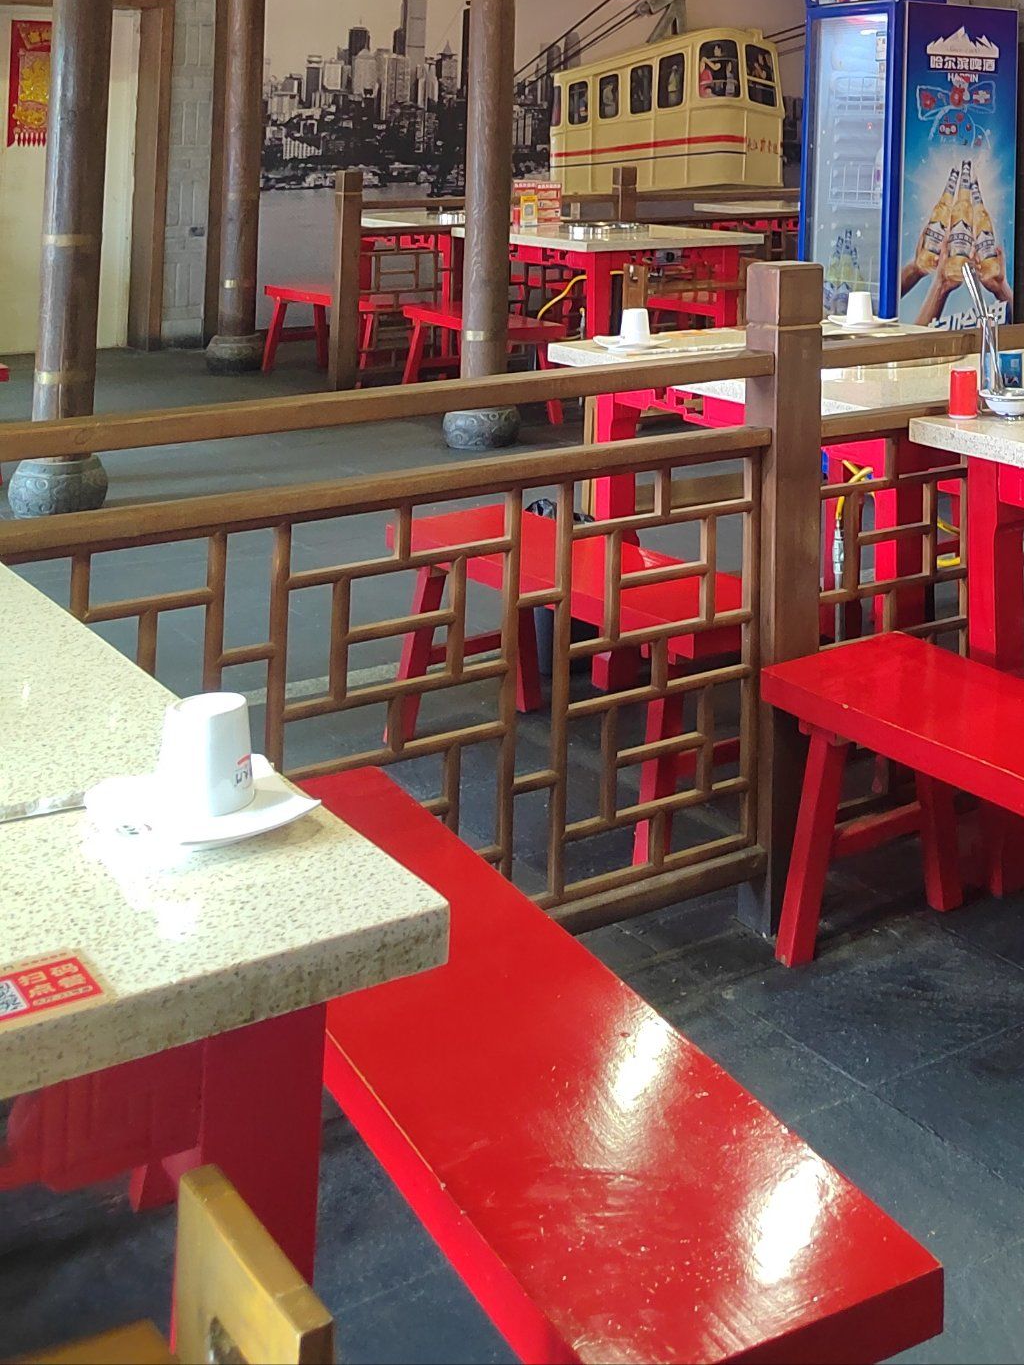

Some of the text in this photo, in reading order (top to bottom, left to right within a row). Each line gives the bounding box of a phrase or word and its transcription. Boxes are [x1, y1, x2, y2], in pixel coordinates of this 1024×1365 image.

[930, 55, 996, 71] 哈尔滨啤酒
